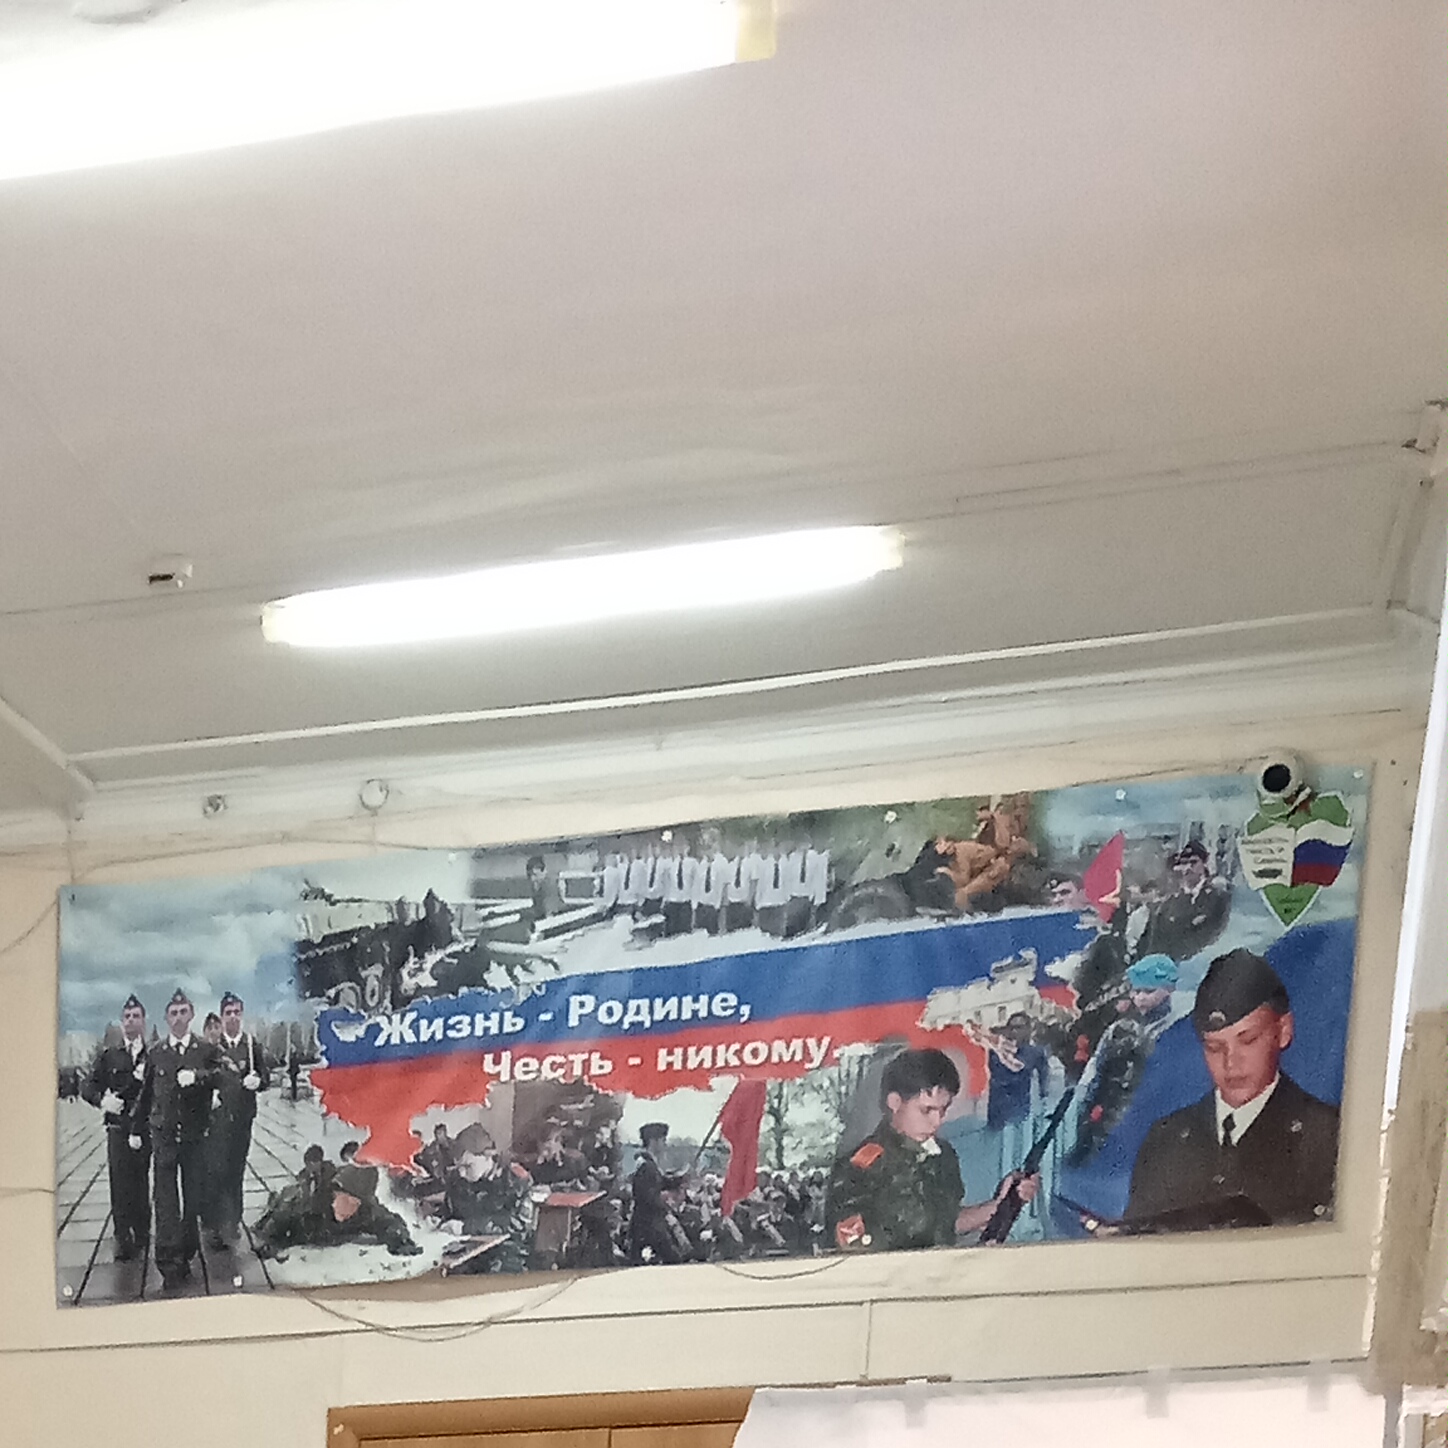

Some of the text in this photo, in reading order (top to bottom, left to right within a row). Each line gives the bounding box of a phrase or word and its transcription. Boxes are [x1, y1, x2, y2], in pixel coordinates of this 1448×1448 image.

[374, 1006, 526, 1047] Жизнь
[567, 989, 752, 1030] Родине,
[483, 1045, 614, 1083] Честь
[656, 1034, 833, 1072] никому
